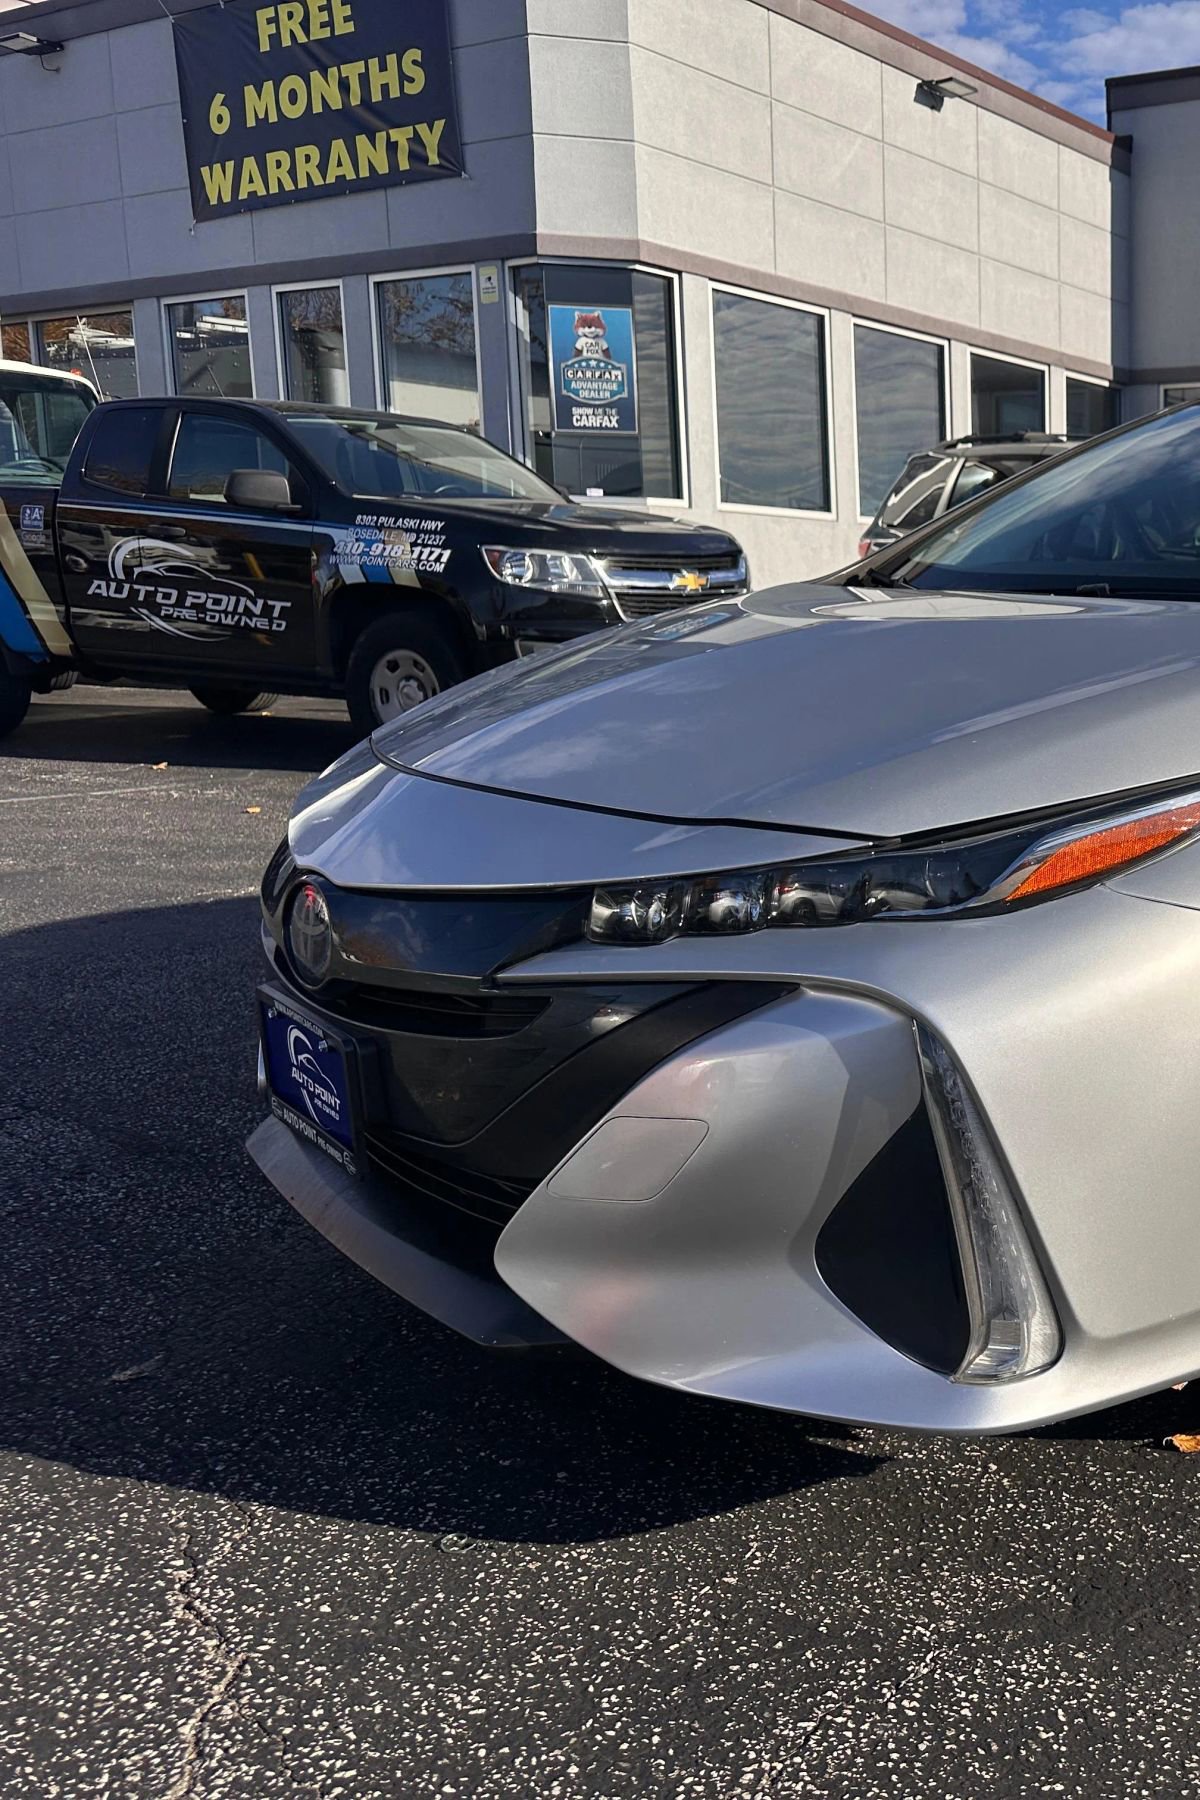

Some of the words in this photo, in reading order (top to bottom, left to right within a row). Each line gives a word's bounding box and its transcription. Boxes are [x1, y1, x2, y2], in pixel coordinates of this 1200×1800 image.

[256, 0, 355, 52] FREE
[209, 92, 231, 135] 6
[243, 48, 426, 128] MONTHS
[200, 119, 446, 206] WARRANTY
[566, 369, 622, 381] CARFAX
[570, 381, 618, 391] ADVANTAGE
[579, 390, 611, 399] DEALER
[572, 407, 594, 416] SHOW
[572, 416, 619, 428] CARFAX
[355, 514, 377, 526] 8302
[377, 516, 419, 529] PULASKI
[420, 519, 445, 531] HWY
[400, 531, 416, 543] MD
[417, 533, 446, 546] 21237
[333, 541, 451, 563] 410-918-1171
[329, 554, 445, 573] WWW.APOINTCARS.COM
[87, 579, 179, 605] AUTO
[184, 590, 292, 618] POINT
[160, 606, 287, 631] PRE-OWNED
[291, 1066, 314, 1092] AUTO
[314, 1083, 341, 1110] POINT
[283, 1108, 299, 1129] AUTO
[299, 1119, 317, 1142] POINT
